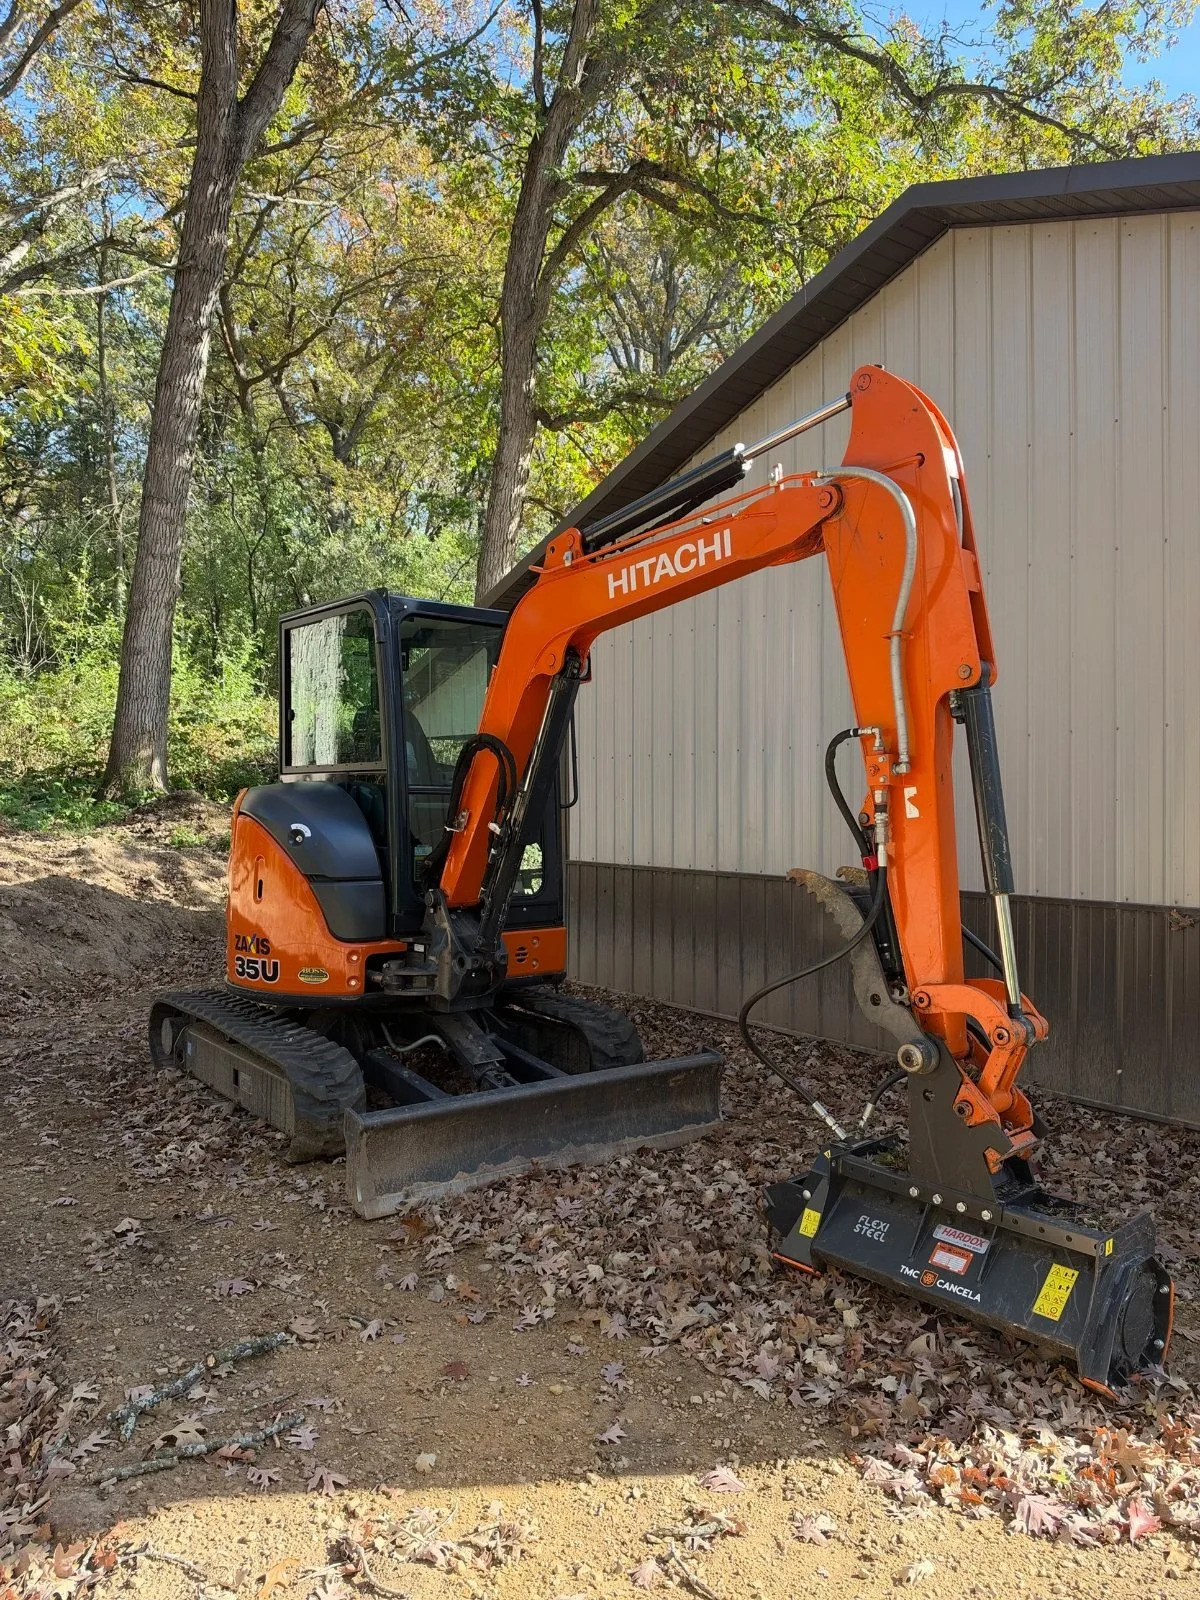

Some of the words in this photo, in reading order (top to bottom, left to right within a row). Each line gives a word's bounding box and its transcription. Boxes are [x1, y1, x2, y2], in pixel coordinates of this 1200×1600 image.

[607, 528, 732, 599] HITACHI
[234, 933, 271, 955] ZAXIS
[235, 955, 279, 983] 35U
[853, 1224, 885, 1243] STEEL
[858, 1215, 890, 1233] FLEXI
[941, 1227, 986, 1248] HARDOX
[900, 1264, 921, 1279] TMC
[936, 1279, 981, 1303] CANCELA
